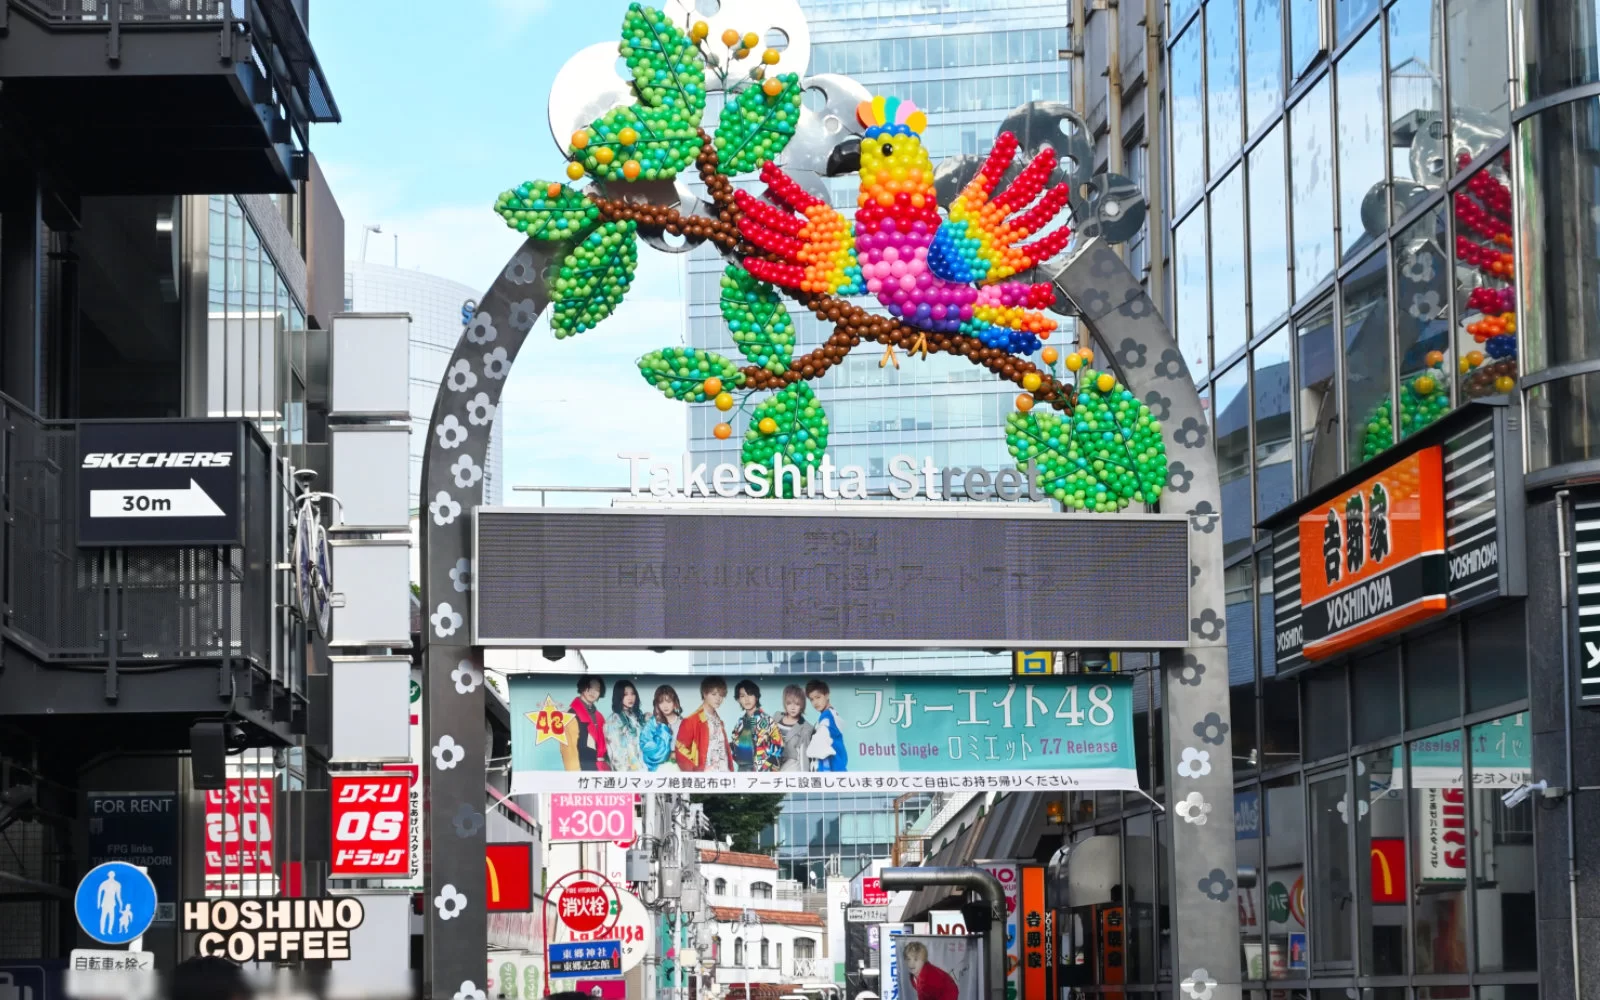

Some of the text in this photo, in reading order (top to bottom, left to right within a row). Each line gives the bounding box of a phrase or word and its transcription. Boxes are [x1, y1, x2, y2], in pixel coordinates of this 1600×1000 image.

[82, 452, 233, 468] SKECHERS
[617, 450, 1044, 502] Takeshita Street
[122, 495, 171, 511] 30m
[1449, 541, 1498, 582] YOSHINOYA
[1326, 576, 1393, 631] YOSHINOYA
[859, 733, 1119, 762] Debut Single ロミエット 7.7 Release
[338, 784, 402, 803] クスリ
[560, 791, 626, 806] PARIS KID'S
[94, 799, 173, 813] FOR RENT
[336, 811, 404, 841] OS
[558, 809, 625, 837] ¥300
[107, 843, 154, 854] FPG links
[336, 849, 406, 866] ドラッグ
[184, 899, 363, 931] HOSHINO
[562, 896, 606, 917] 消火栓
[199, 930, 349, 961] COFFEE
[75, 955, 149, 971] 自転車を除く
